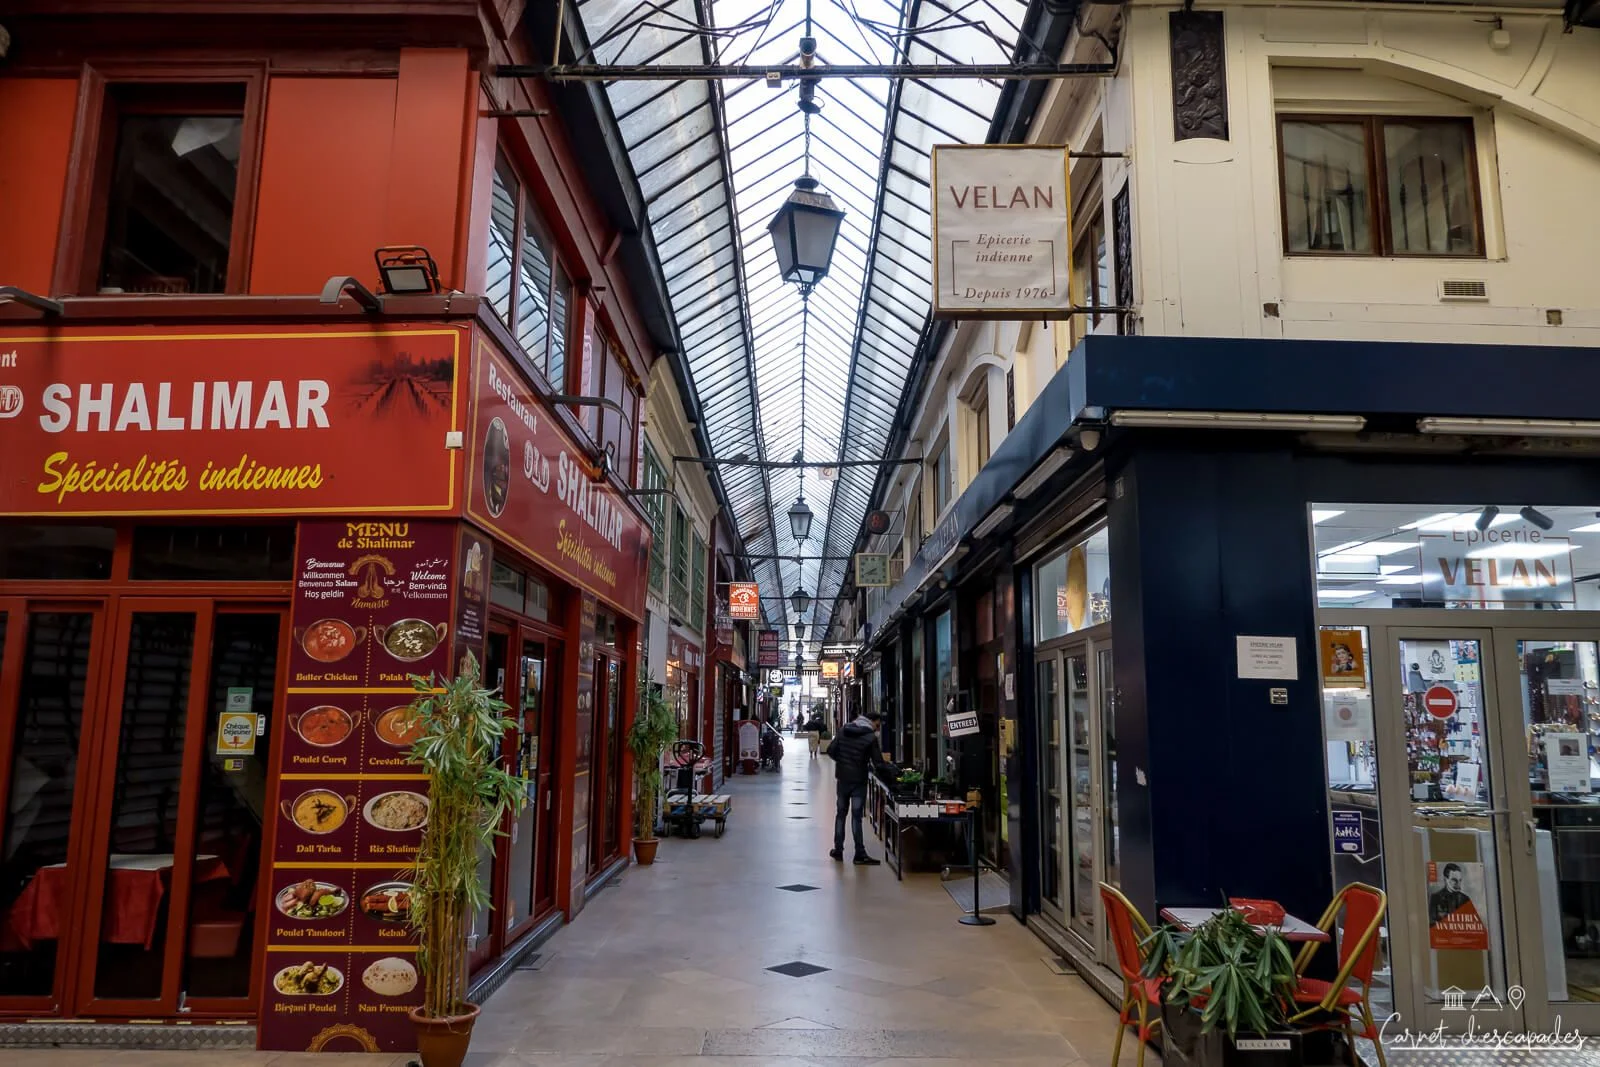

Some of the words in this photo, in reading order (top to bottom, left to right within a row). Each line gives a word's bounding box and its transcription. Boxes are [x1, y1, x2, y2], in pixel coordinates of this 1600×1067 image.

[950, 185, 1053, 209] VELAN
[976, 233, 1031, 248] Epicerie
[976, 251, 1033, 263] indienne
[964, 287, 1010, 302] Depuis
[1015, 287, 1048, 299] 1976
[489, 362, 537, 435] Restaurant
[39, 379, 330, 433] SHALIMAR
[38, 451, 188, 504] Spécialités
[199, 453, 323, 492] indiennes
[523, 439, 550, 494] OLD
[557, 450, 623, 552] SHALIMAR
[347, 523, 408, 537] MENU
[1452, 525, 1542, 546] Epicerie
[338, 538, 353, 549] de
[357, 538, 415, 549] Shalimar
[556, 519, 594, 572] Spécialités
[306, 558, 345, 570] Bienvenue
[410, 570, 446, 581] Welcome
[1438, 557, 1557, 587] VELAN
[383, 577, 405, 587] مرحبا
[409, 582, 447, 590] Bem-vinda
[305, 590, 319, 599] Hoş
[321, 590, 344, 600] geldin
[403, 591, 448, 599] Velkommen
[351, 597, 390, 609] Namaste
[296, 673, 323, 681] Butter
[324, 673, 358, 681] Chicken
[379, 673, 403, 681] Palak
[293, 755, 320, 763] Poulet
[322, 755, 347, 765] Curry
[369, 757, 404, 765] Crevette
[297, 845, 314, 853] Dall
[316, 845, 342, 853] Tarka
[369, 845, 384, 853] Riz
[386, 845, 421, 853] Shalima
[276, 928, 304, 937] Poulet
[306, 928, 346, 937] Tandoori
[378, 928, 407, 937] Kebab
[274, 1003, 307, 1013] Biryani
[309, 1003, 337, 1012] Poulet
[358, 1003, 377, 1012] Nan
[379, 1003, 414, 1014] Fromag
